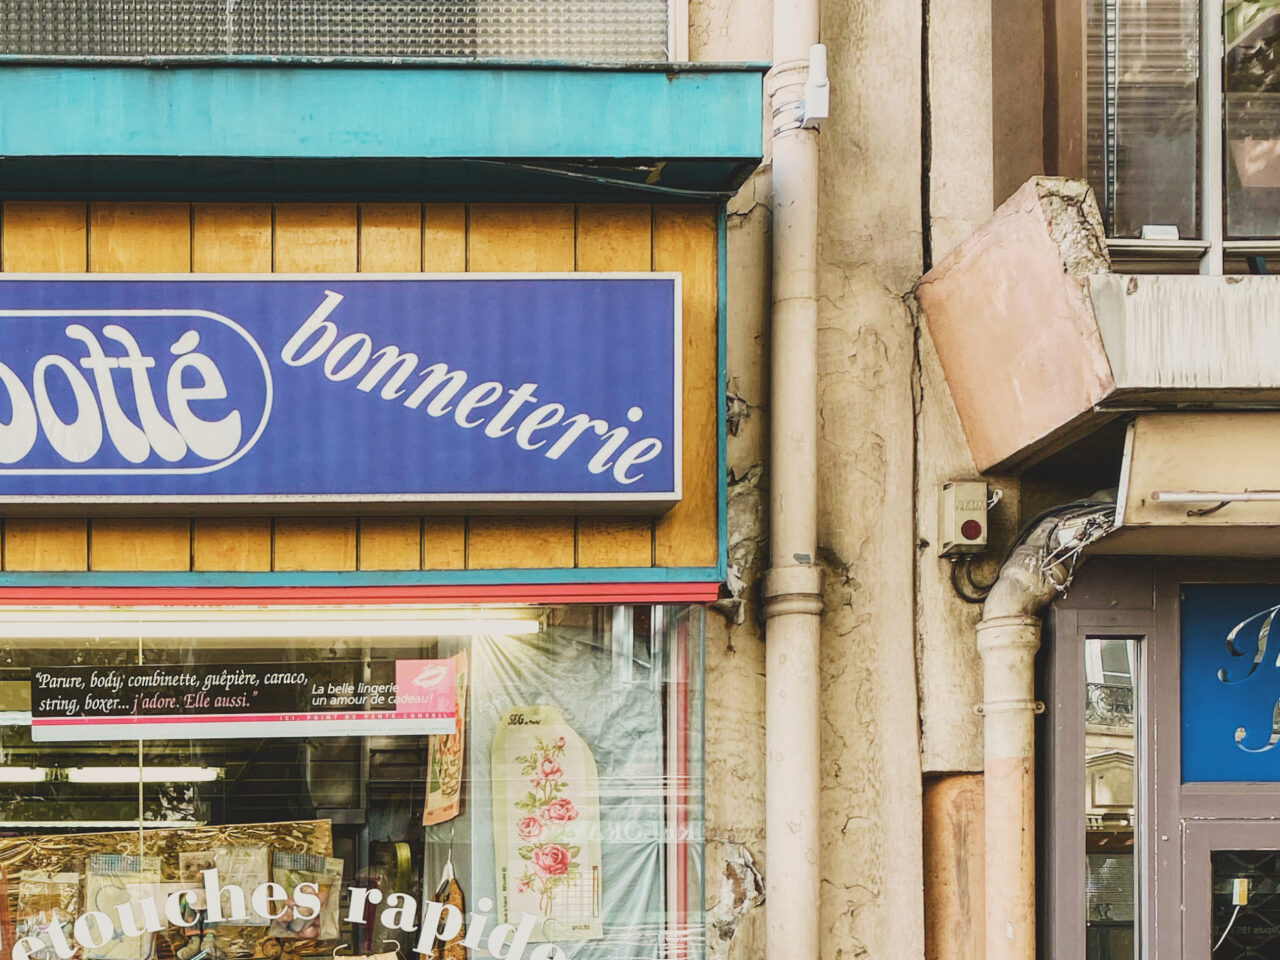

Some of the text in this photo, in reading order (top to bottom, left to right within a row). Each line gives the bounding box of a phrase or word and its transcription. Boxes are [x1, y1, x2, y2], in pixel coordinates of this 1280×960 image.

[281, 289, 663, 485] bonneterie
[128, 669, 201, 688] combinette,
[204, 669, 261, 692] guêpière,
[264, 671, 309, 687] caraco,
[312, 681, 399, 697] La belle lingerie
[38, 695, 81, 716] string,
[184, 691, 211, 709] Elle
[312, 696, 328, 706] un
[329, 695, 368, 706] amour
[369, 693, 386, 705] de
[345, 713, 358, 721] DE
